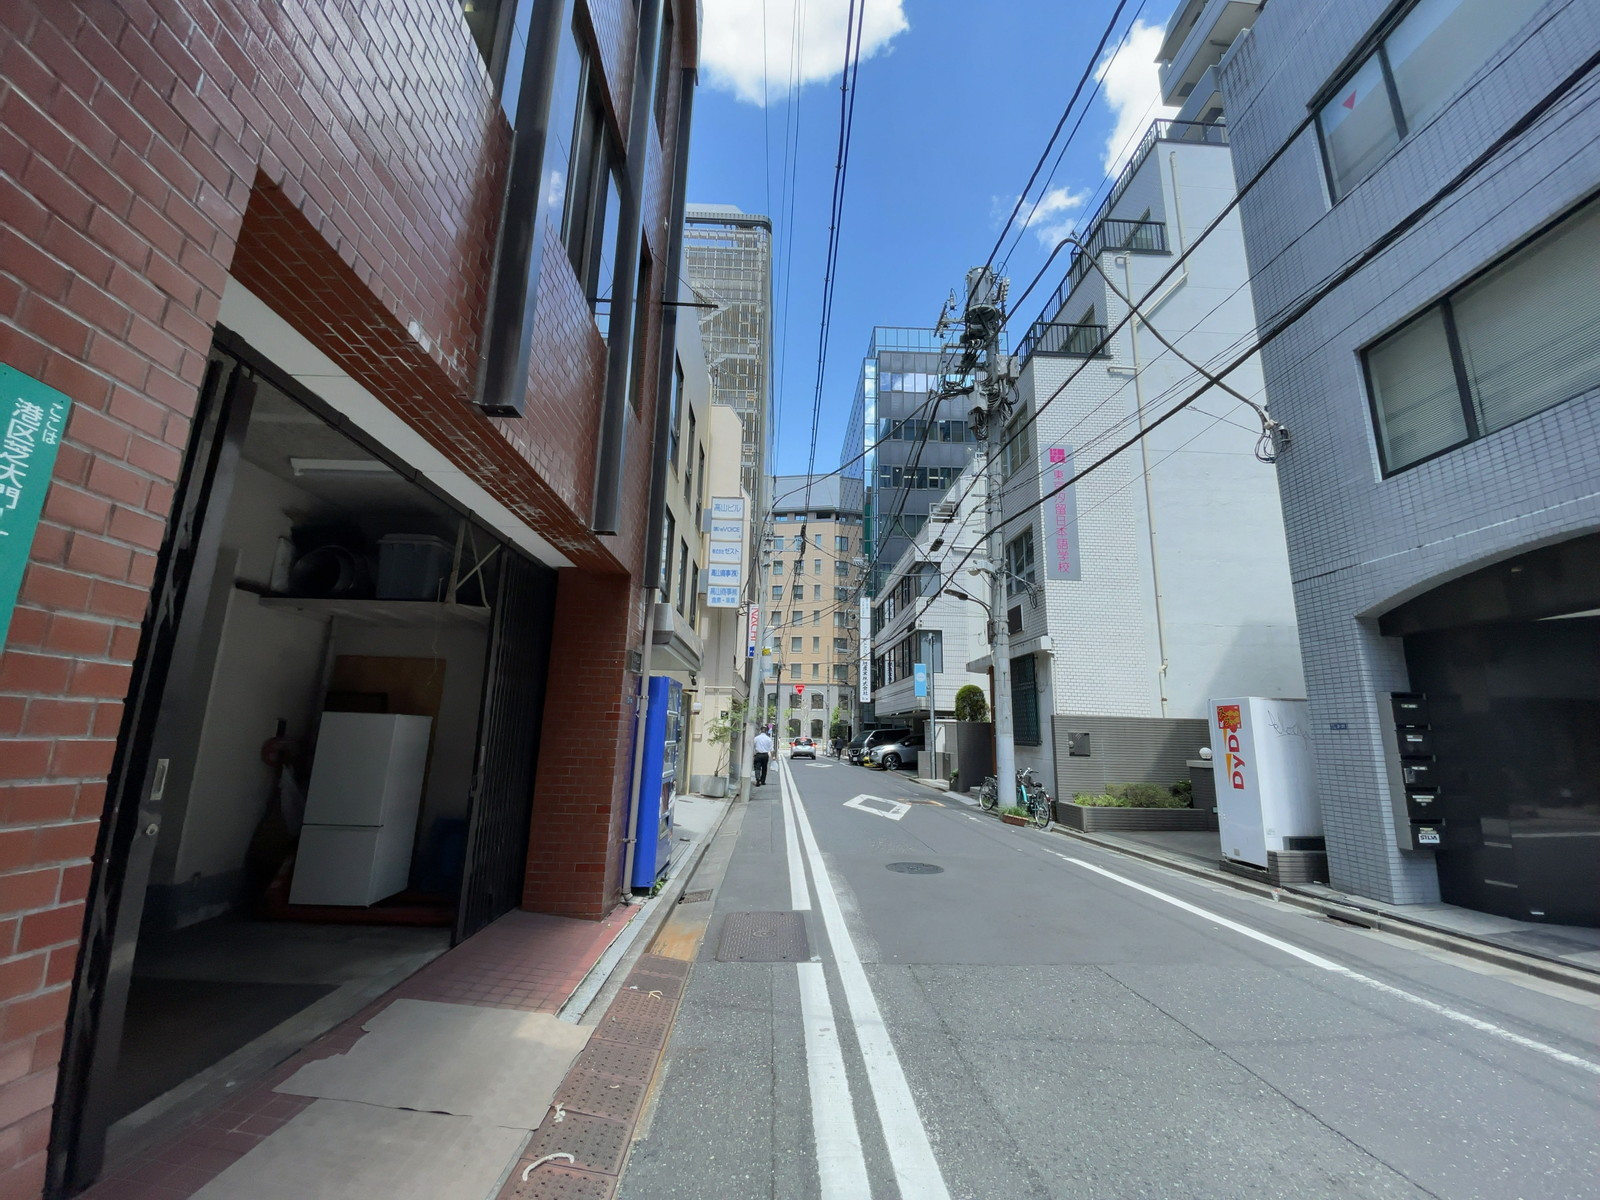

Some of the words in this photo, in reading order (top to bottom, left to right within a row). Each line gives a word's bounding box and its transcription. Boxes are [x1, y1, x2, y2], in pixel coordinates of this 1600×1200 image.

[42, 402, 64, 445] ここは
[713, 503, 742, 513] 高山ビル
